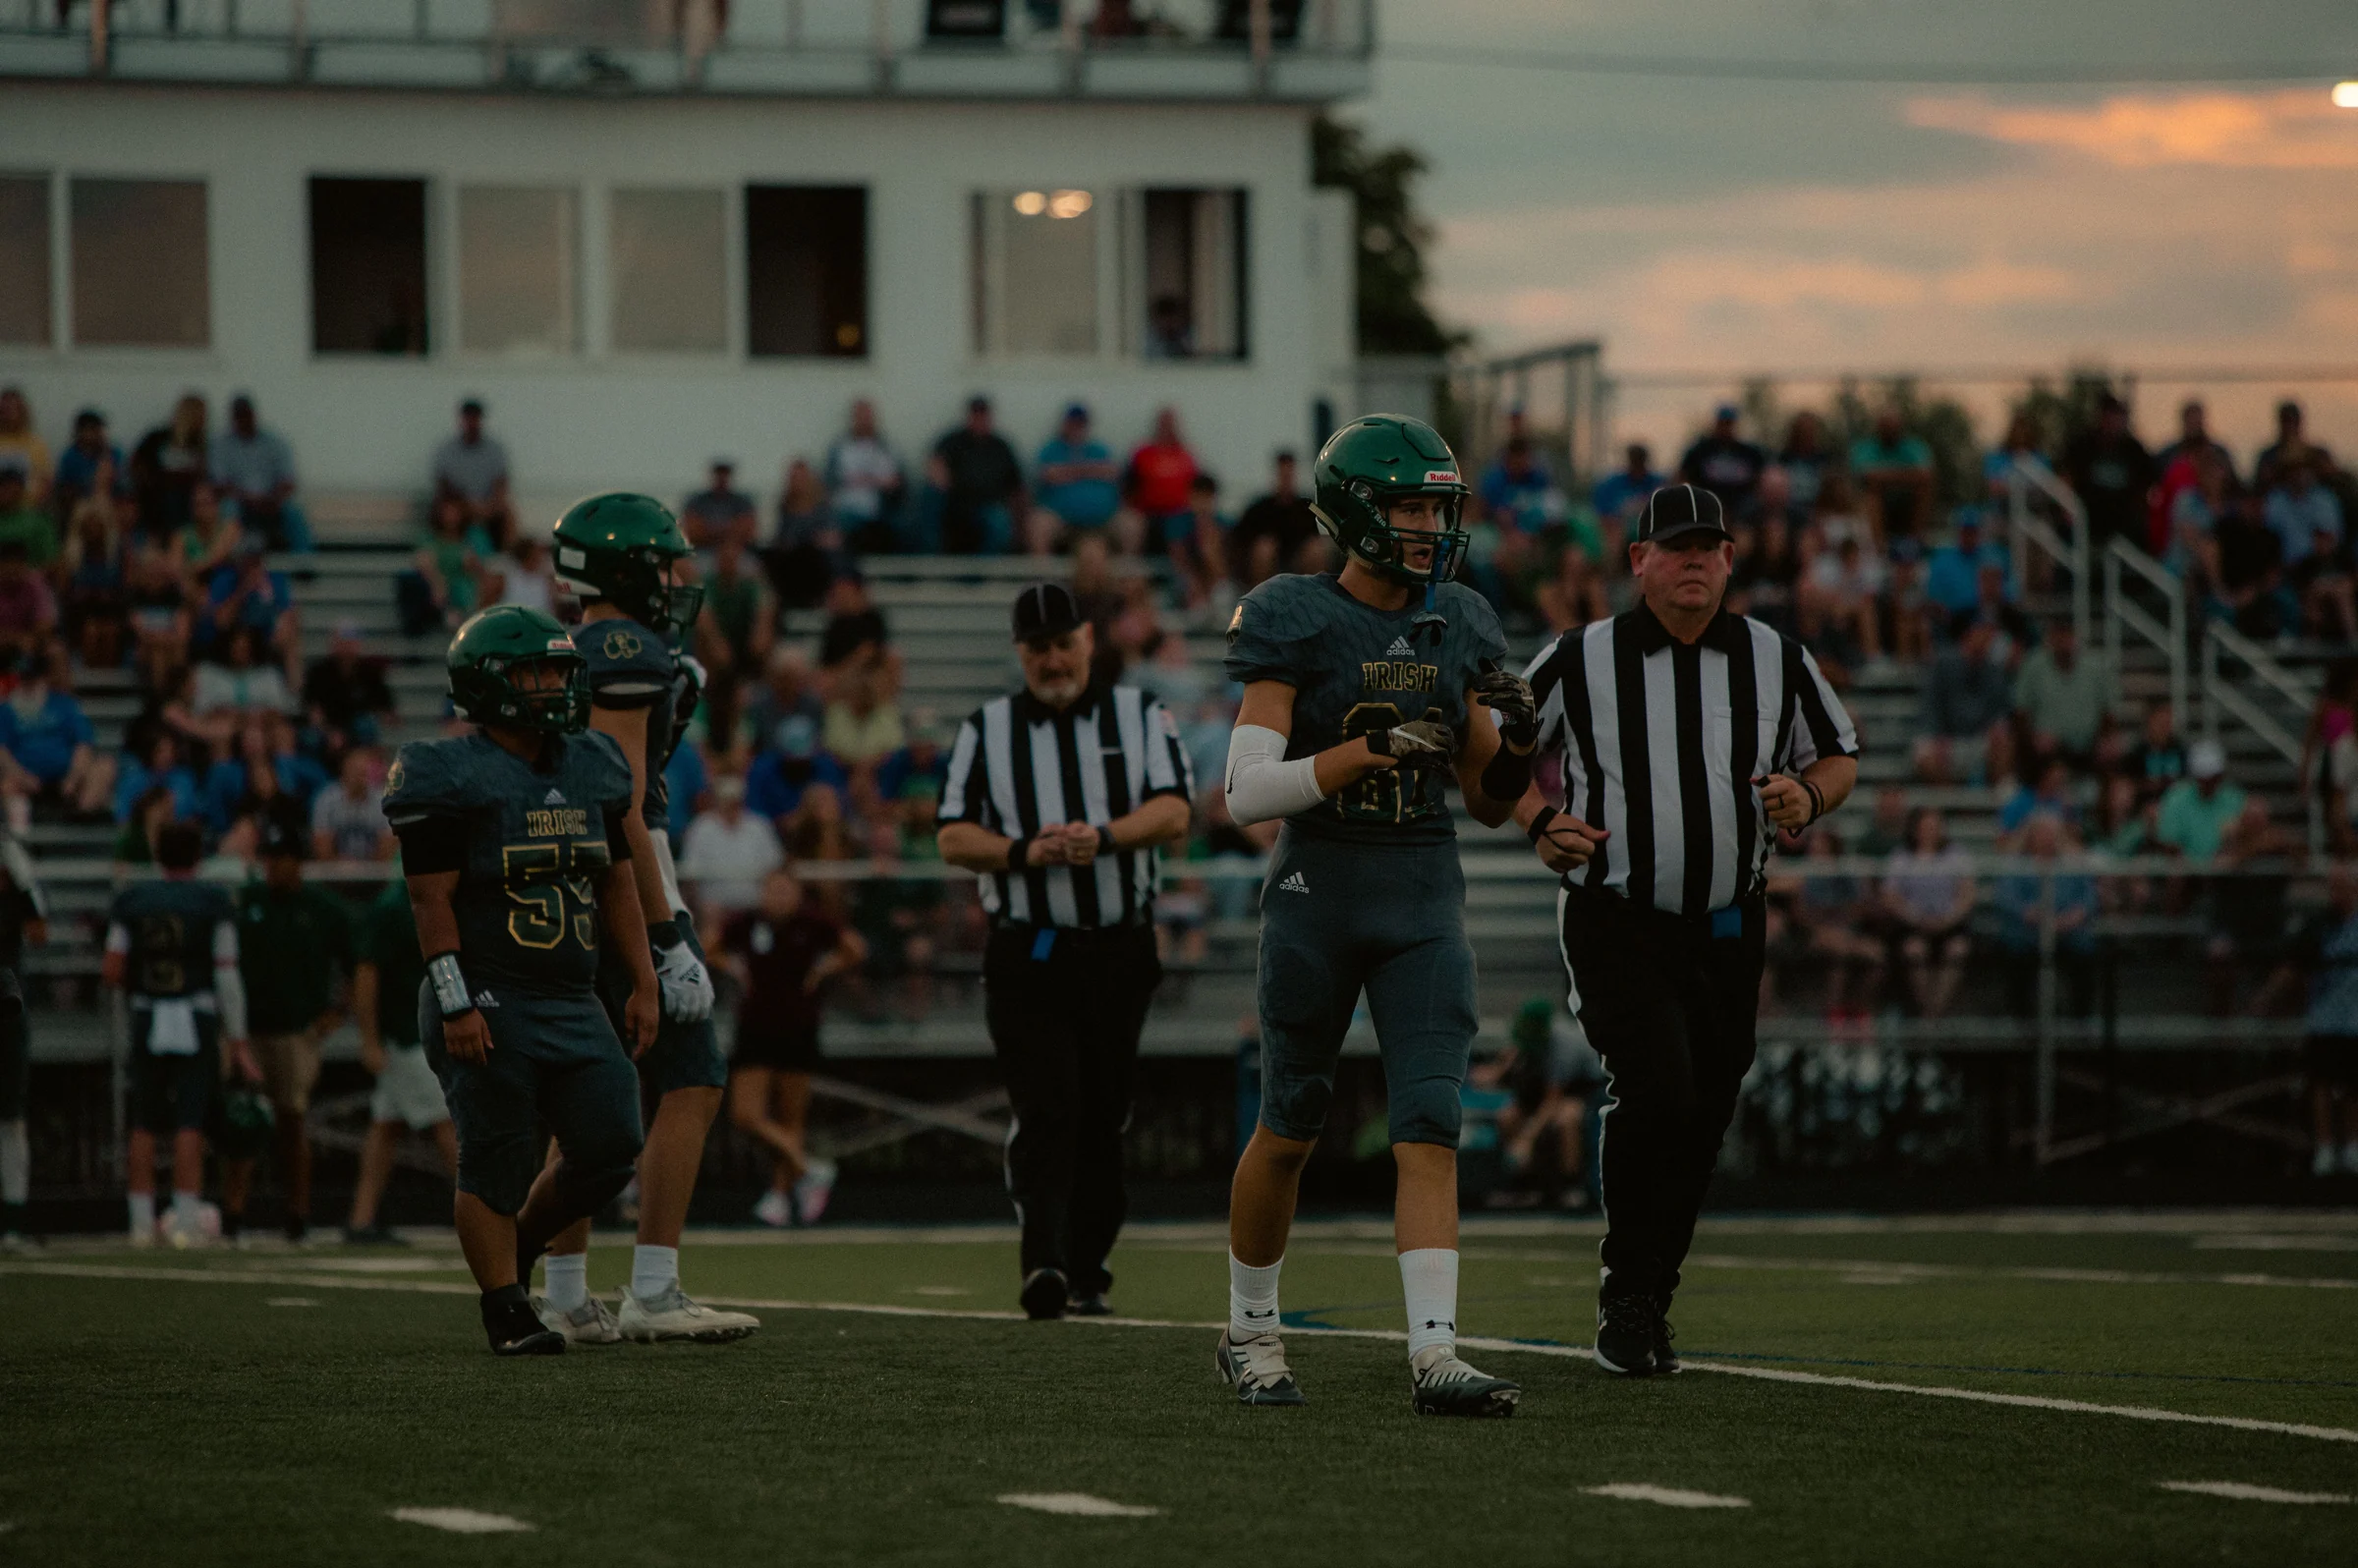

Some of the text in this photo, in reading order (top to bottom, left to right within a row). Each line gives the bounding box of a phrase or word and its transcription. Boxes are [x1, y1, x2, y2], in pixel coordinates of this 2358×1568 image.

[1430, 473, 1456, 481] Riddell
[1386, 647, 1415, 656] adidas
[1362, 661, 1438, 693] IRISH
[526, 809, 589, 837] IRISH
[1279, 883, 1310, 894] adidas
